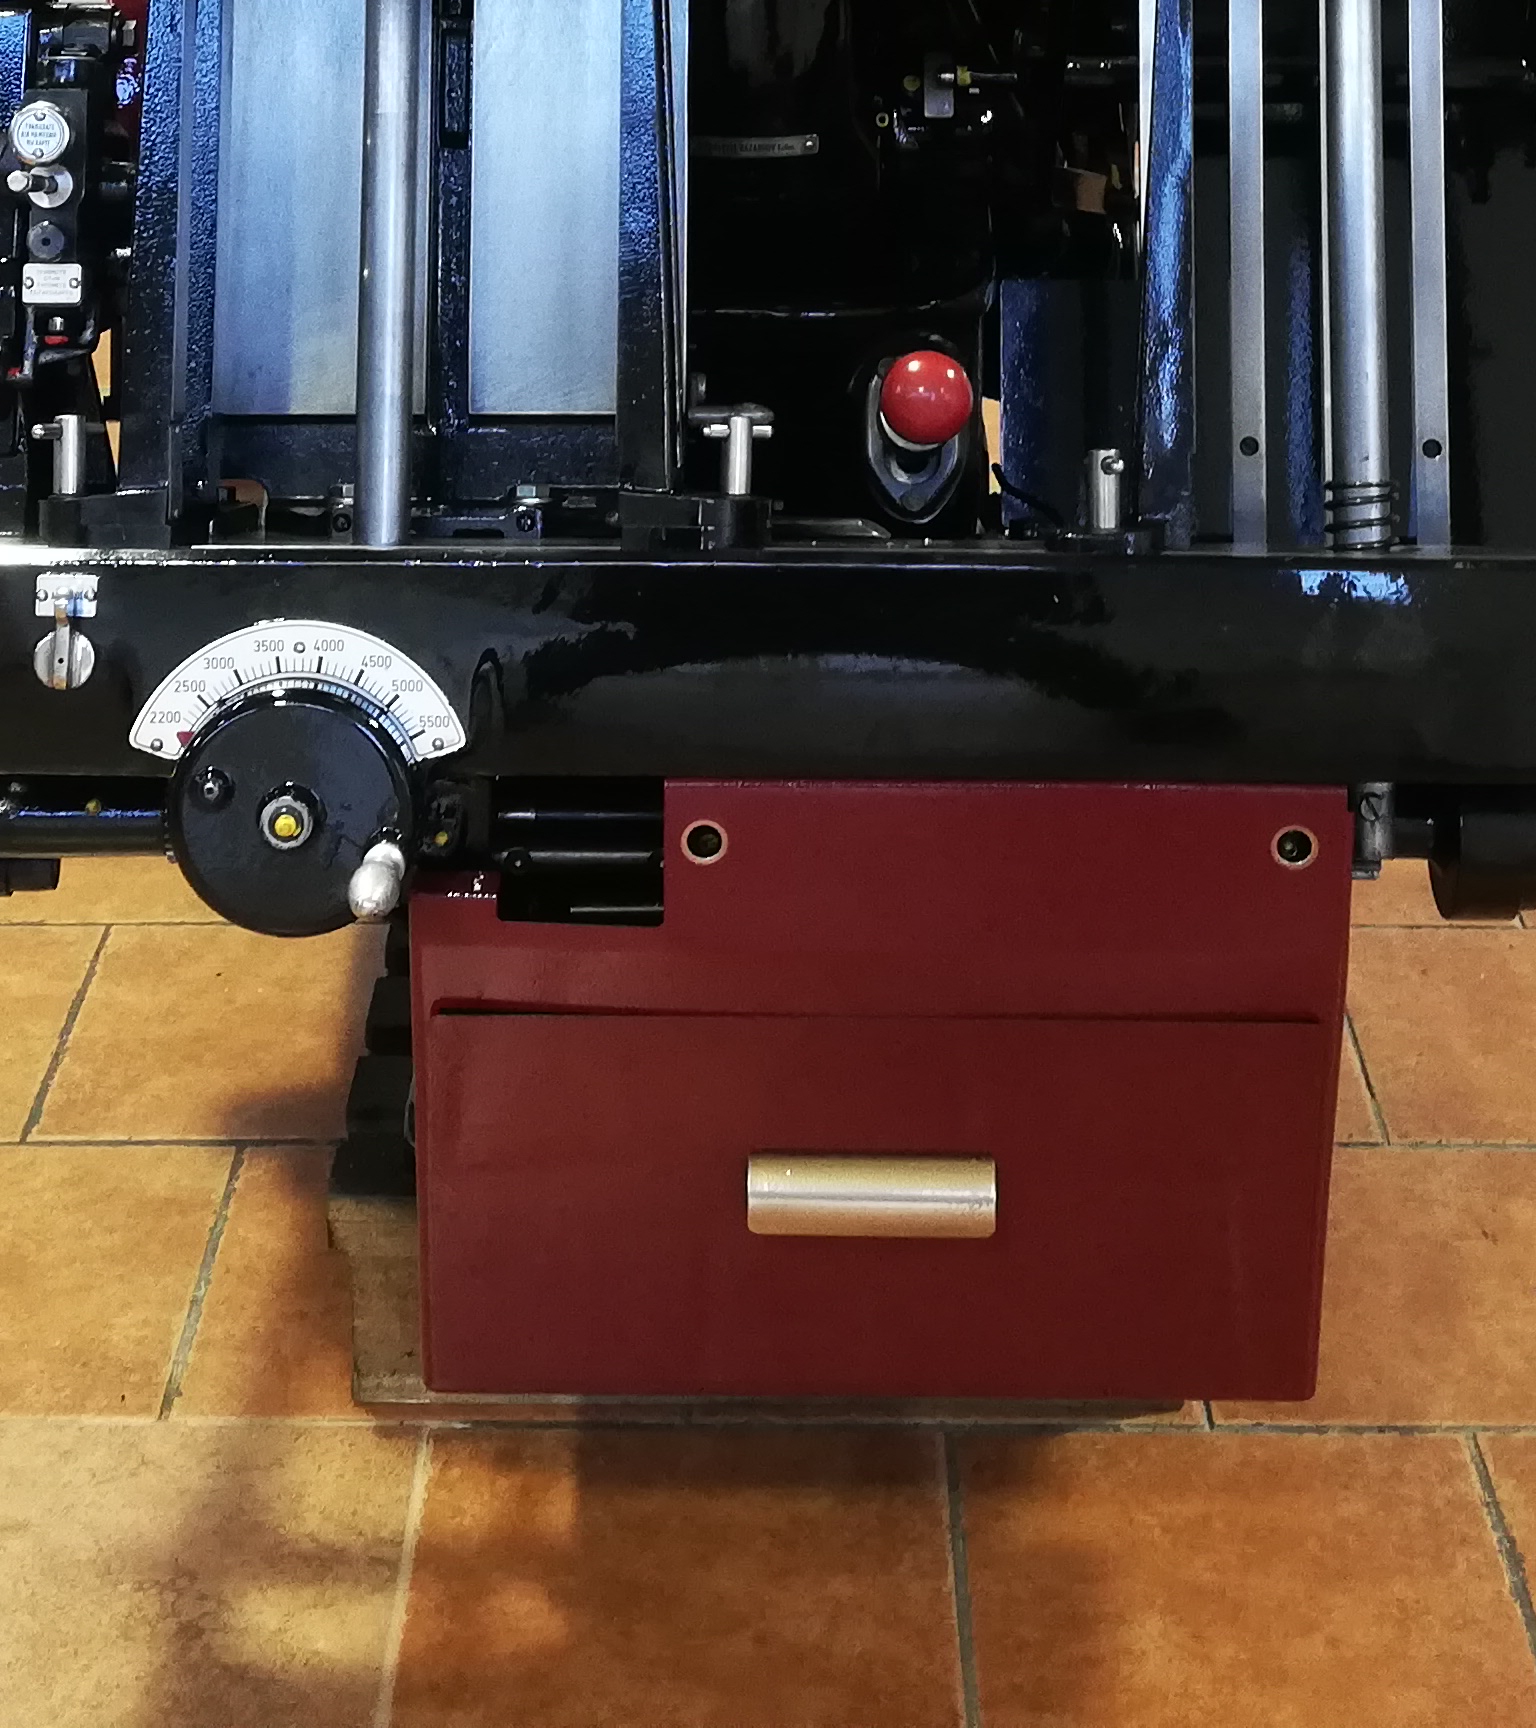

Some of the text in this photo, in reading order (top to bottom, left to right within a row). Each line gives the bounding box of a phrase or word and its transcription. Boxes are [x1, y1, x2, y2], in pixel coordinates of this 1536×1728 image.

[253, 640, 285, 652] 3500
[313, 640, 344, 652] 4000
[203, 657, 235, 670] 3000
[361, 656, 392, 669] 4500
[174, 680, 206, 693] 2500
[392, 680, 423, 693] 5000
[149, 711, 181, 724] 2200
[419, 716, 450, 728] 5500
